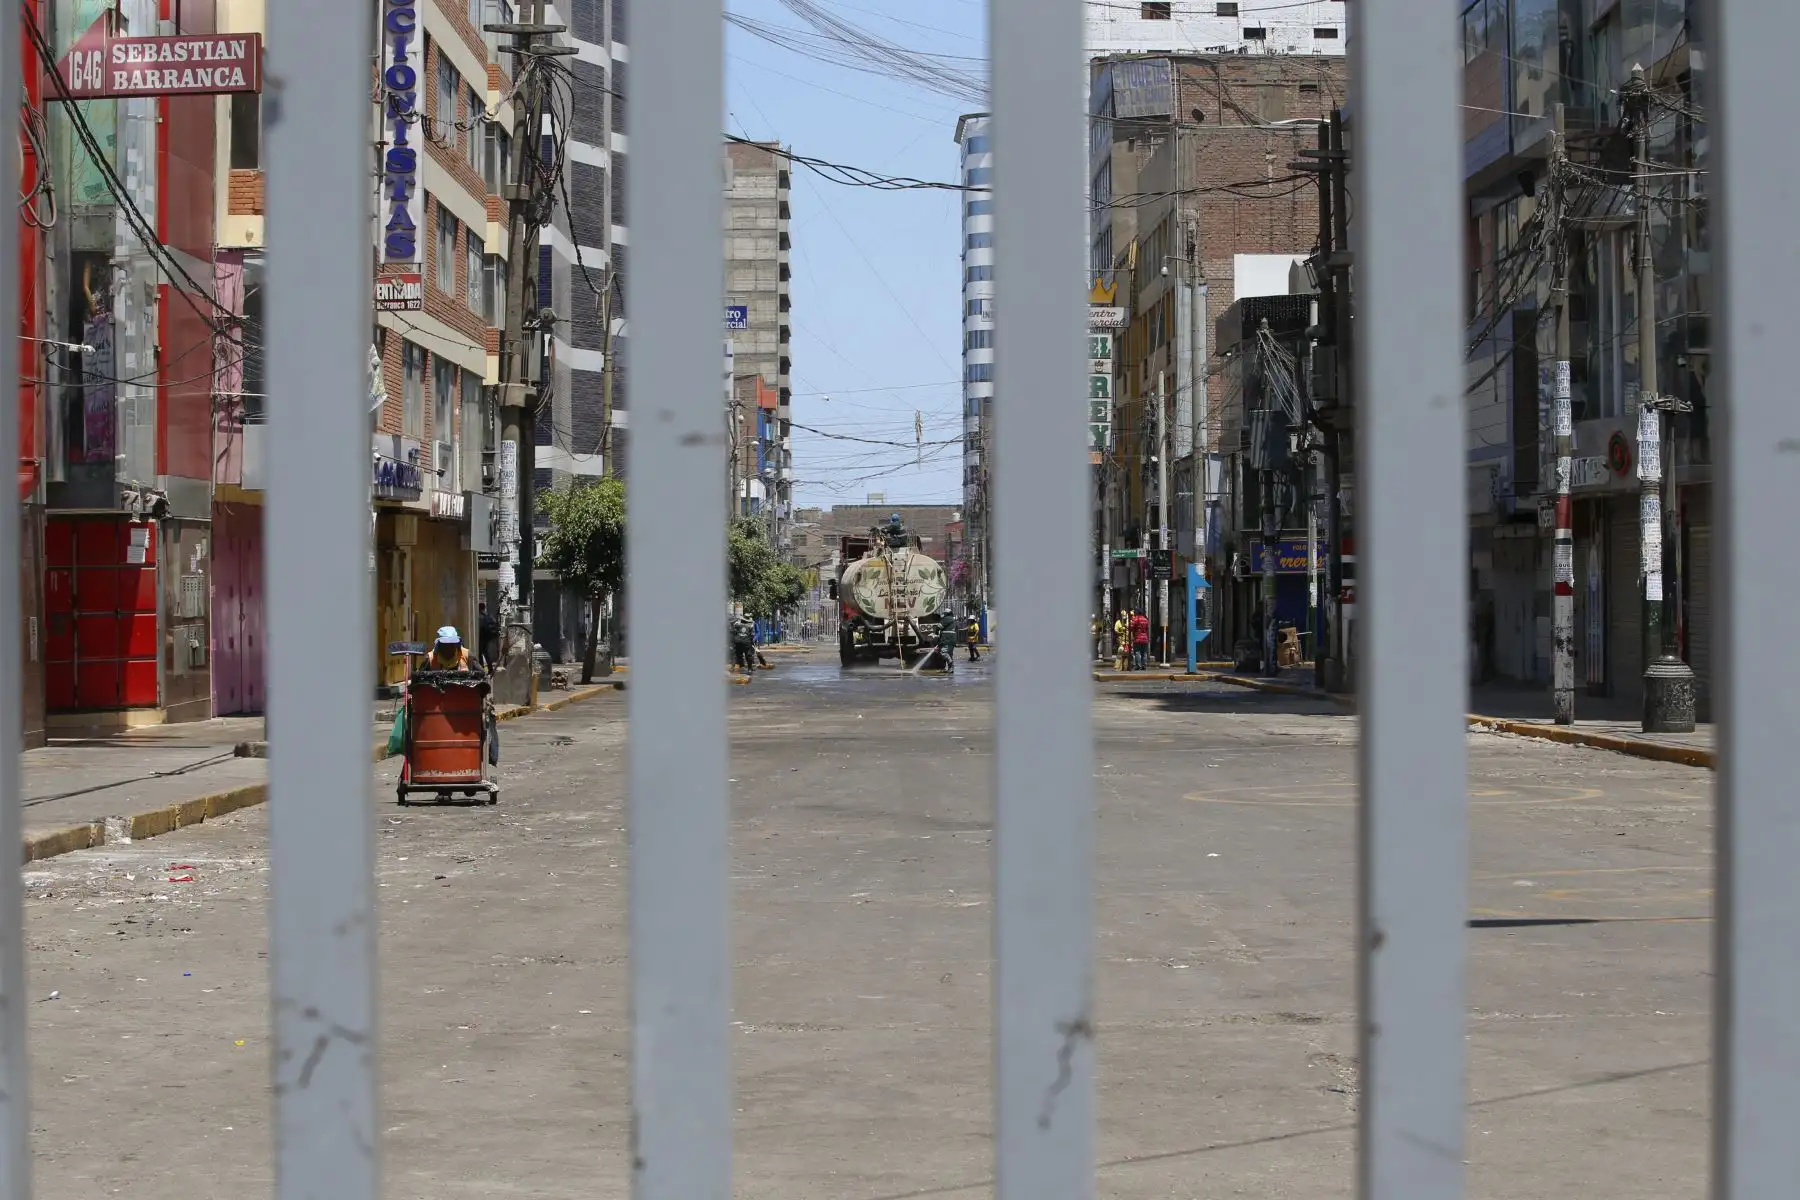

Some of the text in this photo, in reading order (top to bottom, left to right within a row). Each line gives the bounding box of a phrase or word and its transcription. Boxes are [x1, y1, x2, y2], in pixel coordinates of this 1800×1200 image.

[112, 40, 246, 64] SEBASTIAN
[68, 51, 101, 90] 1646
[112, 67, 246, 90] BARRANCA
[385, 0, 416, 258] CIONISTAS
